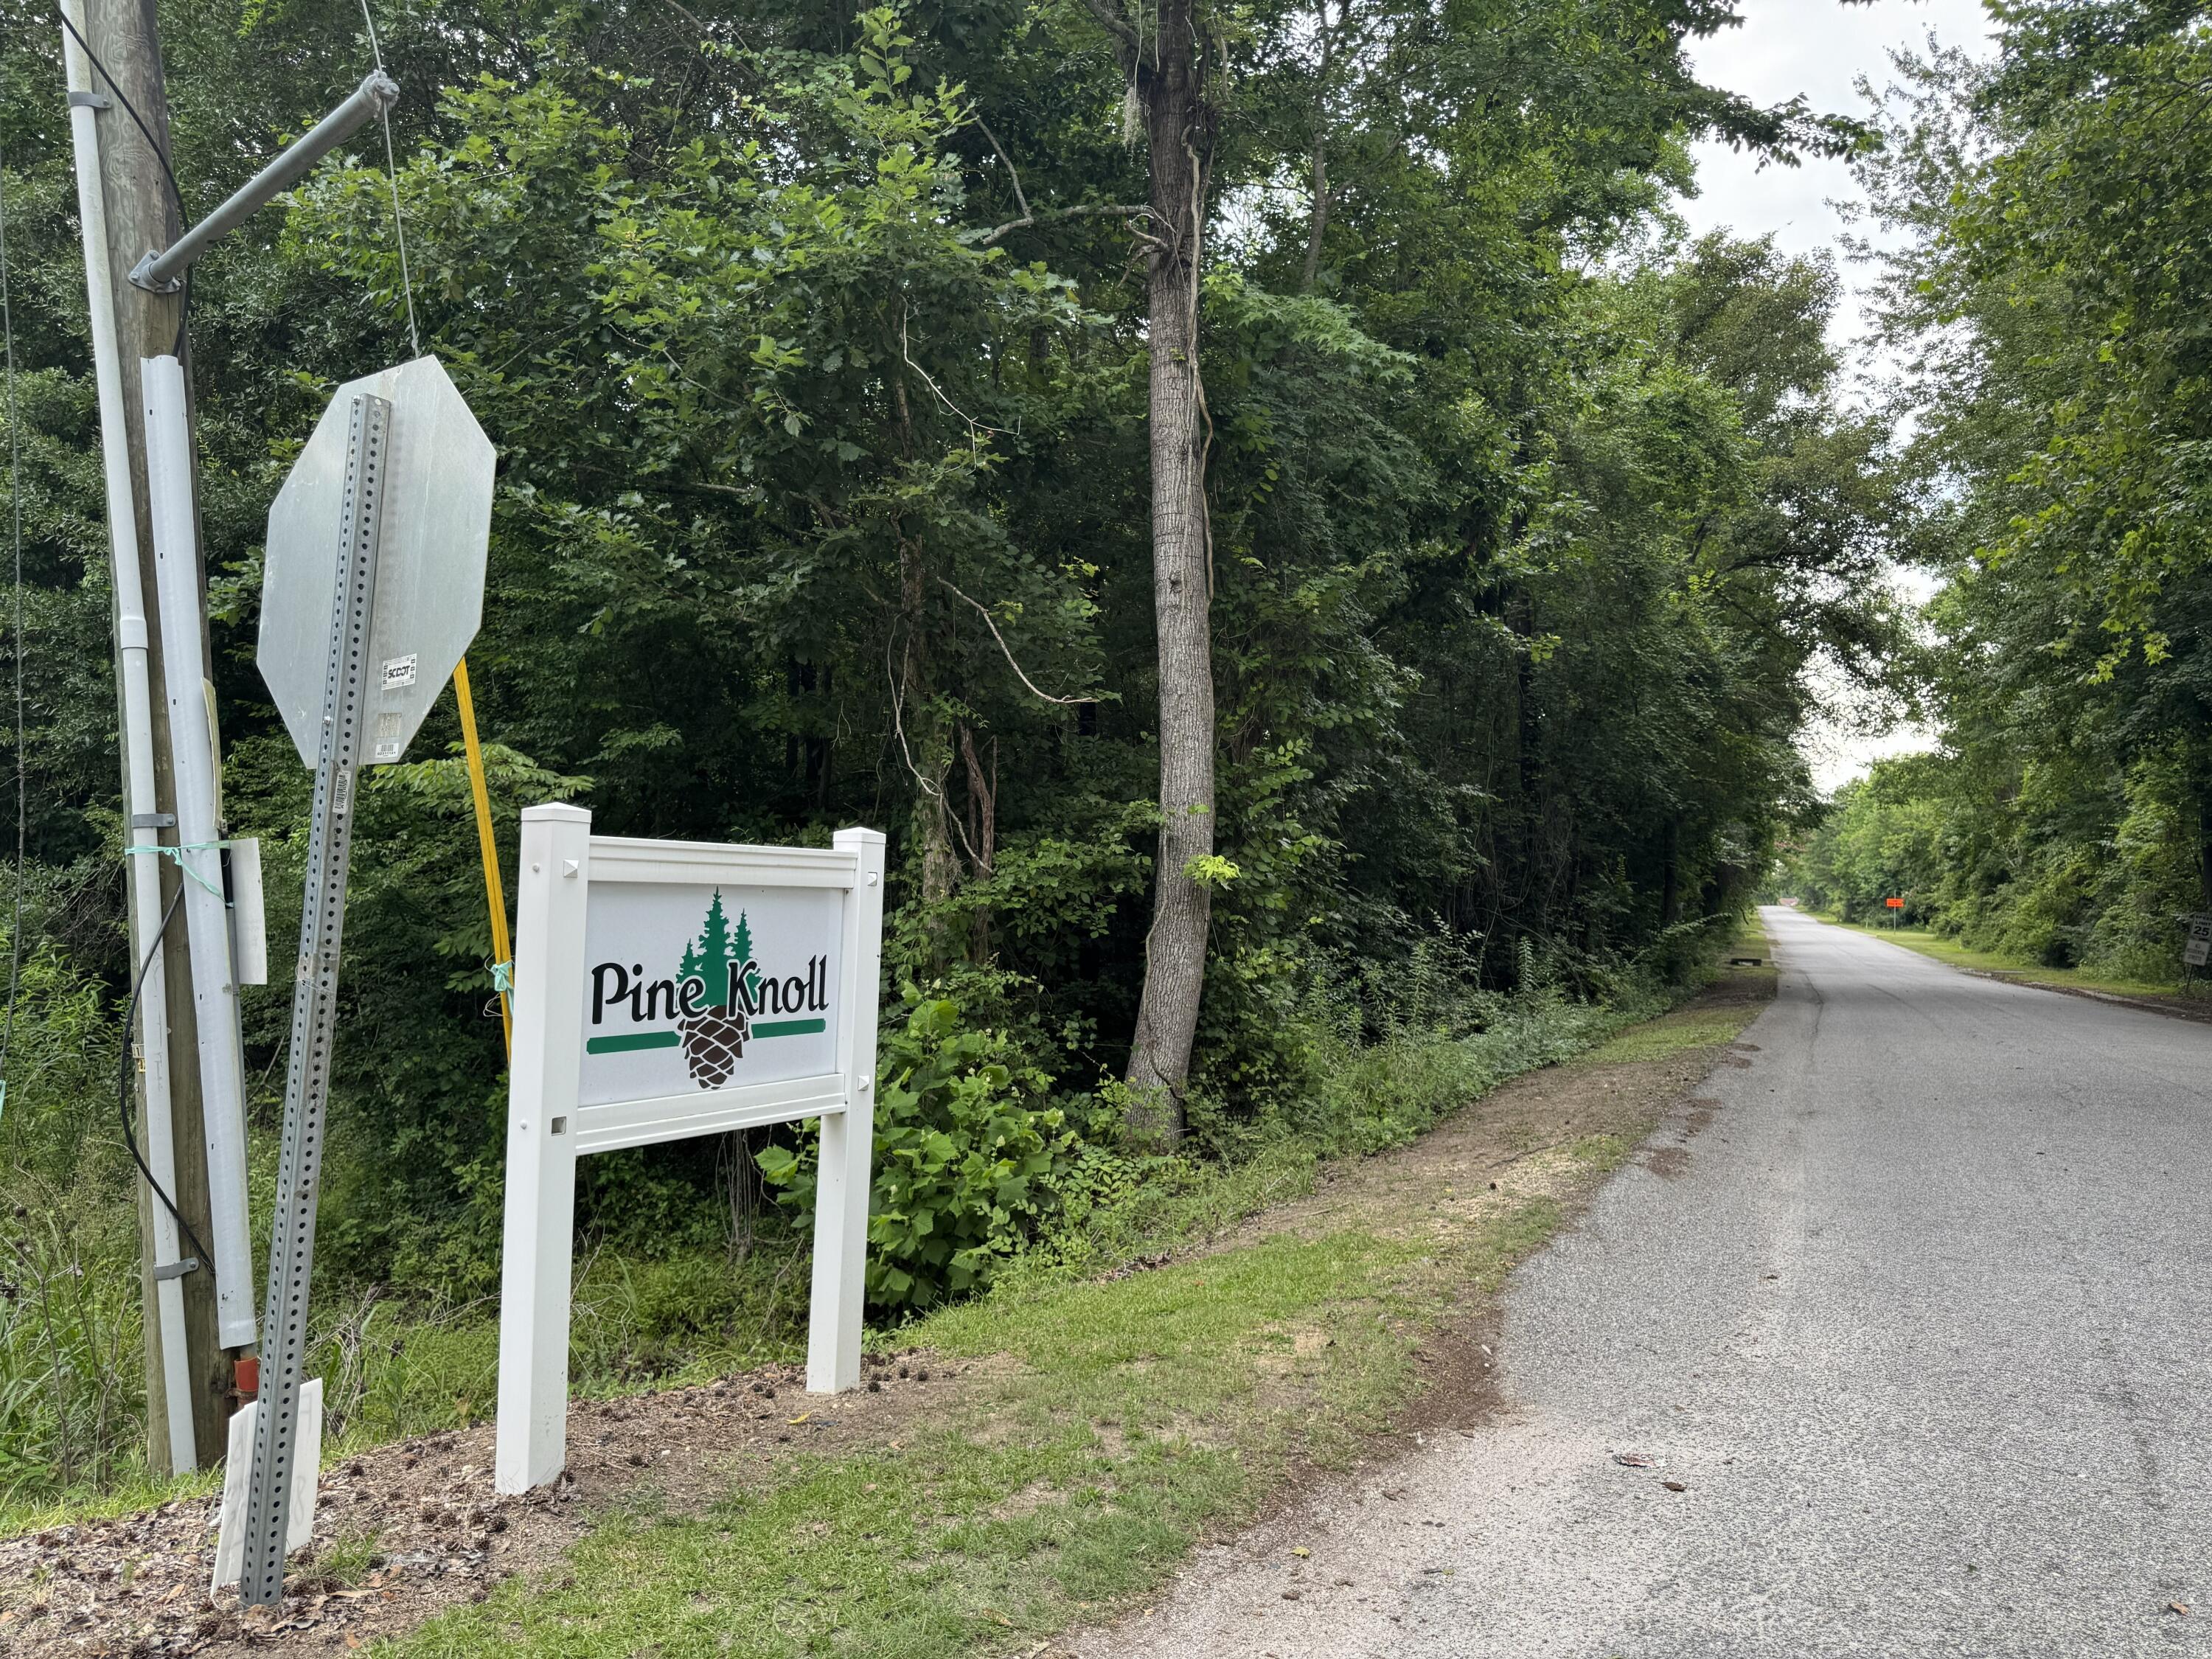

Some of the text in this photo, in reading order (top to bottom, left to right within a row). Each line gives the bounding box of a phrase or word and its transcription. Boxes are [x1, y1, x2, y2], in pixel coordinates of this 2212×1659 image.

[388, 665, 410, 678] SCDOT
[2194, 926, 2210, 936] 25
[591, 954, 830, 1025] Pine Knoll
